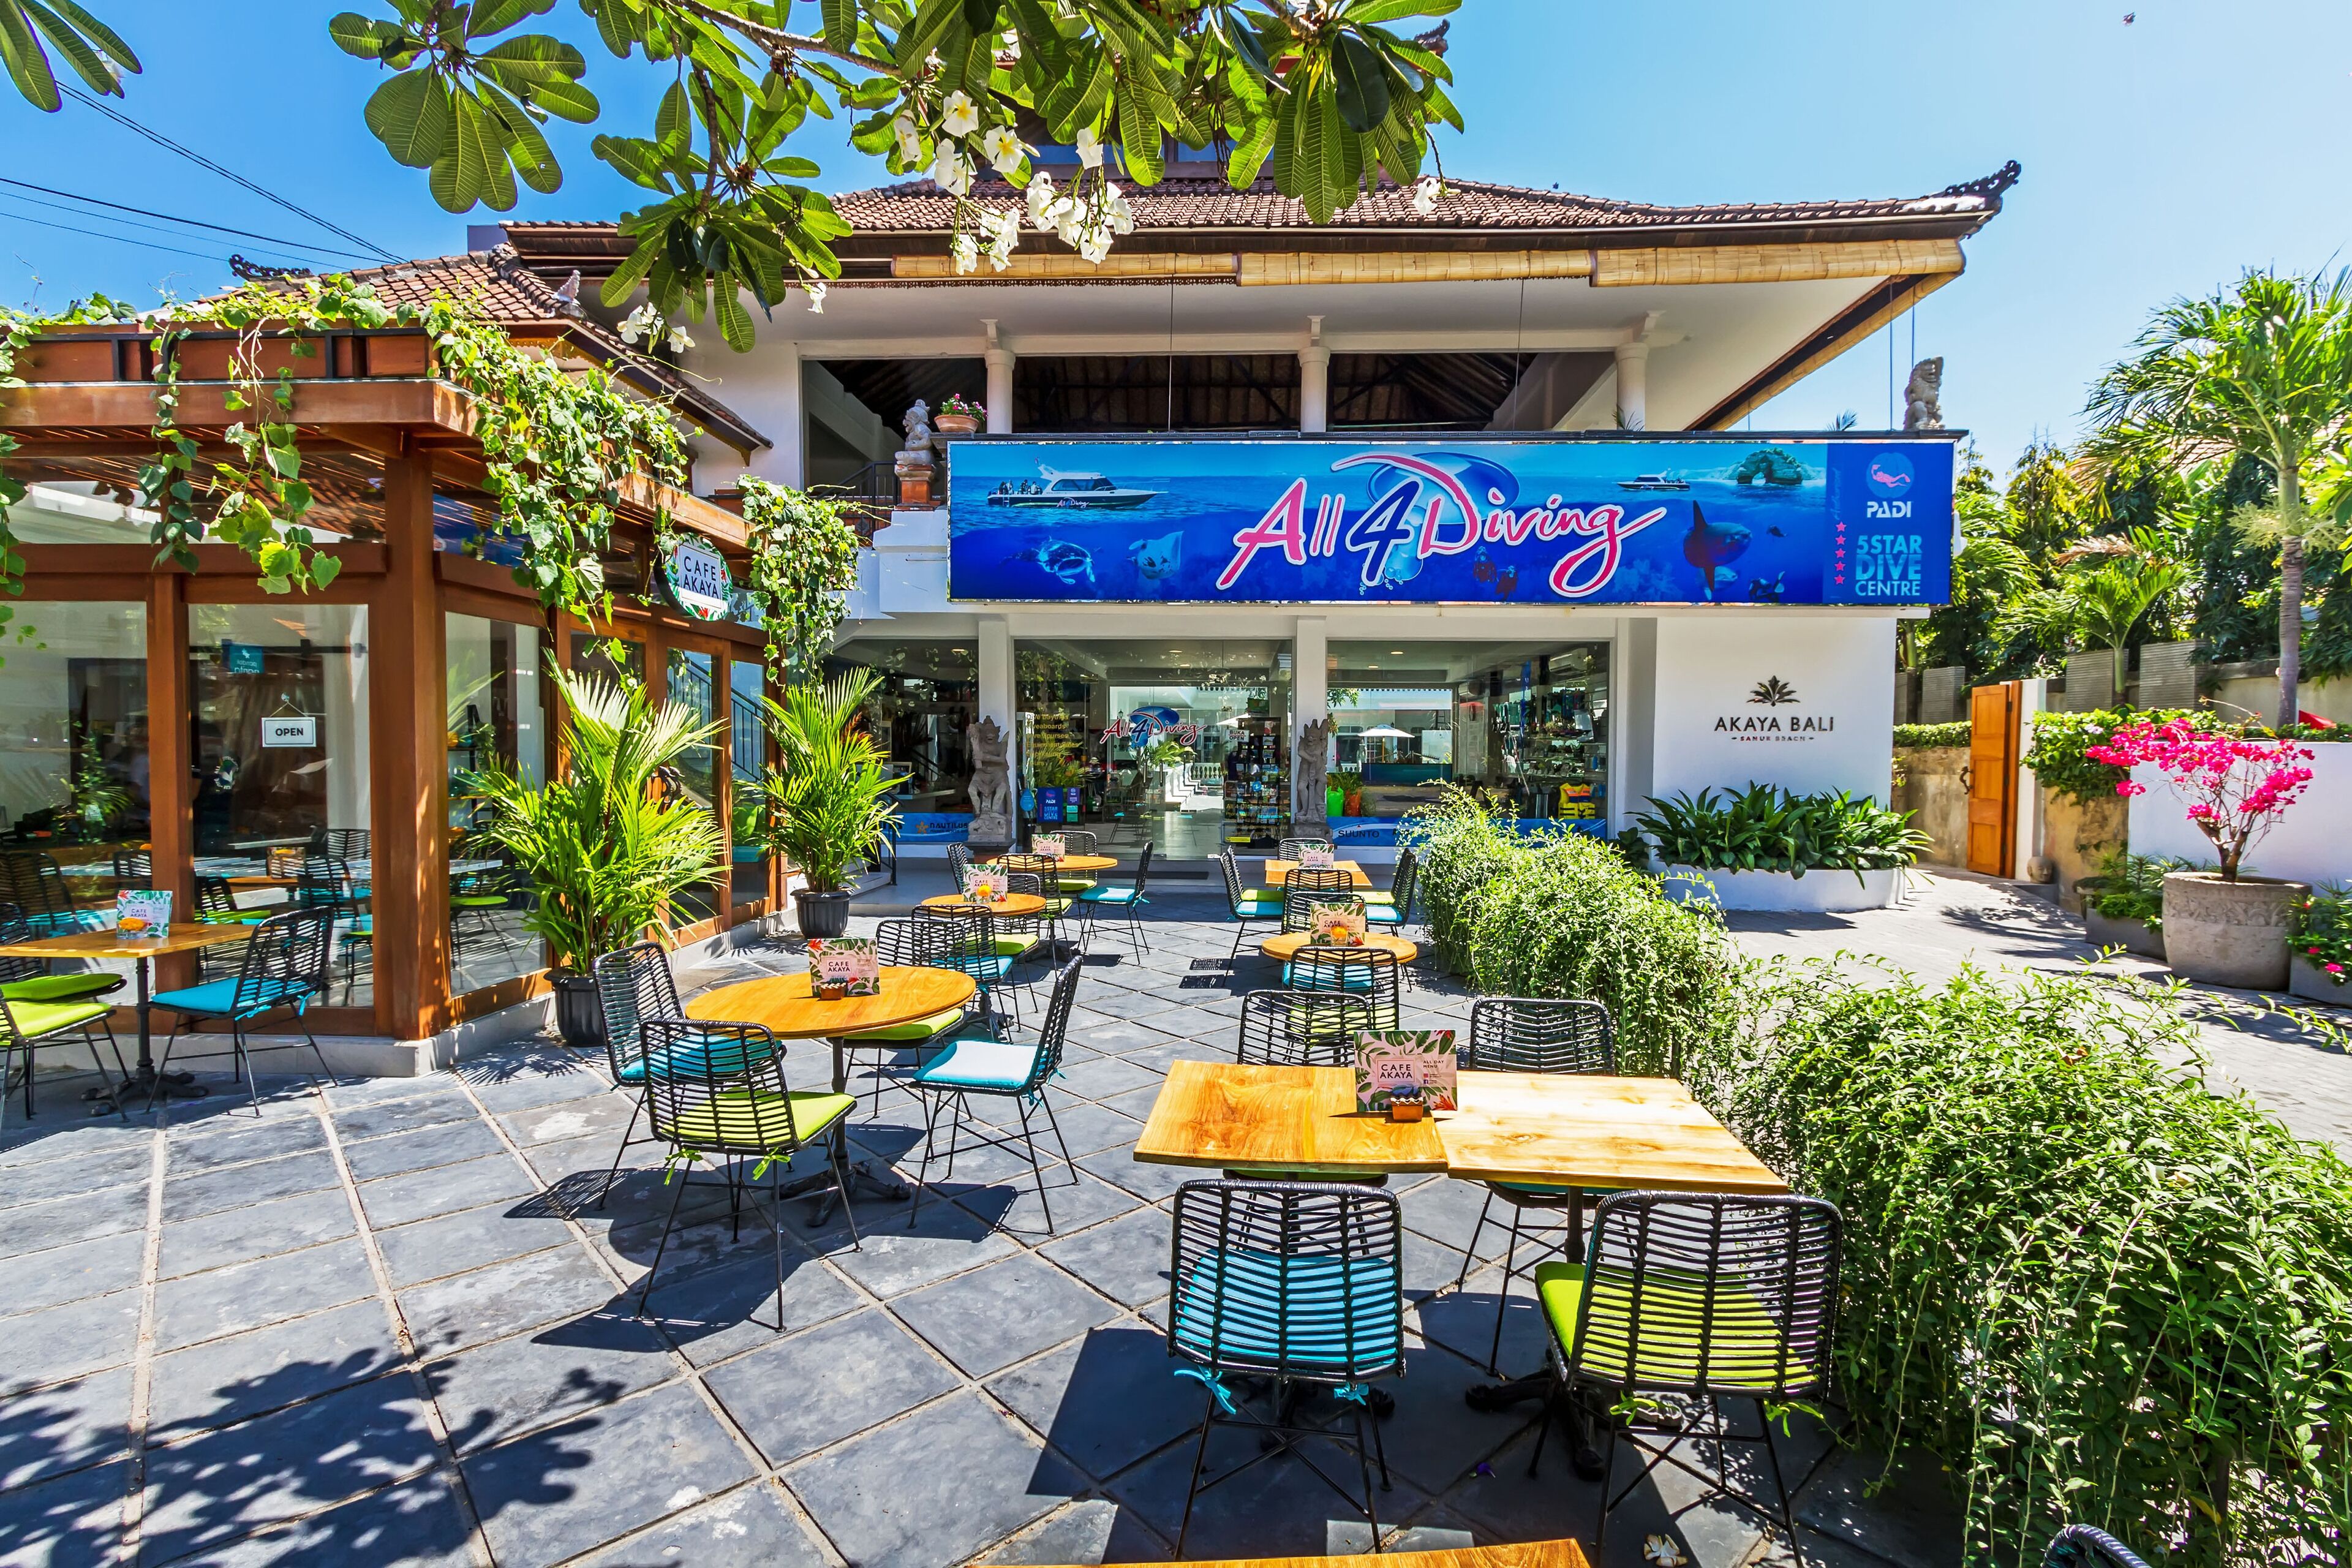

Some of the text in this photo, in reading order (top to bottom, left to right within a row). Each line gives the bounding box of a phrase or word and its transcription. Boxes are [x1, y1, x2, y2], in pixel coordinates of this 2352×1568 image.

[1867, 501, 1912, 518] PADI
[1216, 451, 1667, 597] All 4 Diving
[684, 556, 717, 581] CAFE
[1855, 554, 1922, 580] DIVE
[683, 574, 719, 600] AKAYA
[1855, 581, 1920, 597] CENTRE
[275, 728, 304, 736] OPEN
[1099, 711, 1207, 745] All 4 Diving
[1714, 717, 1834, 731] AKAYA BALI
